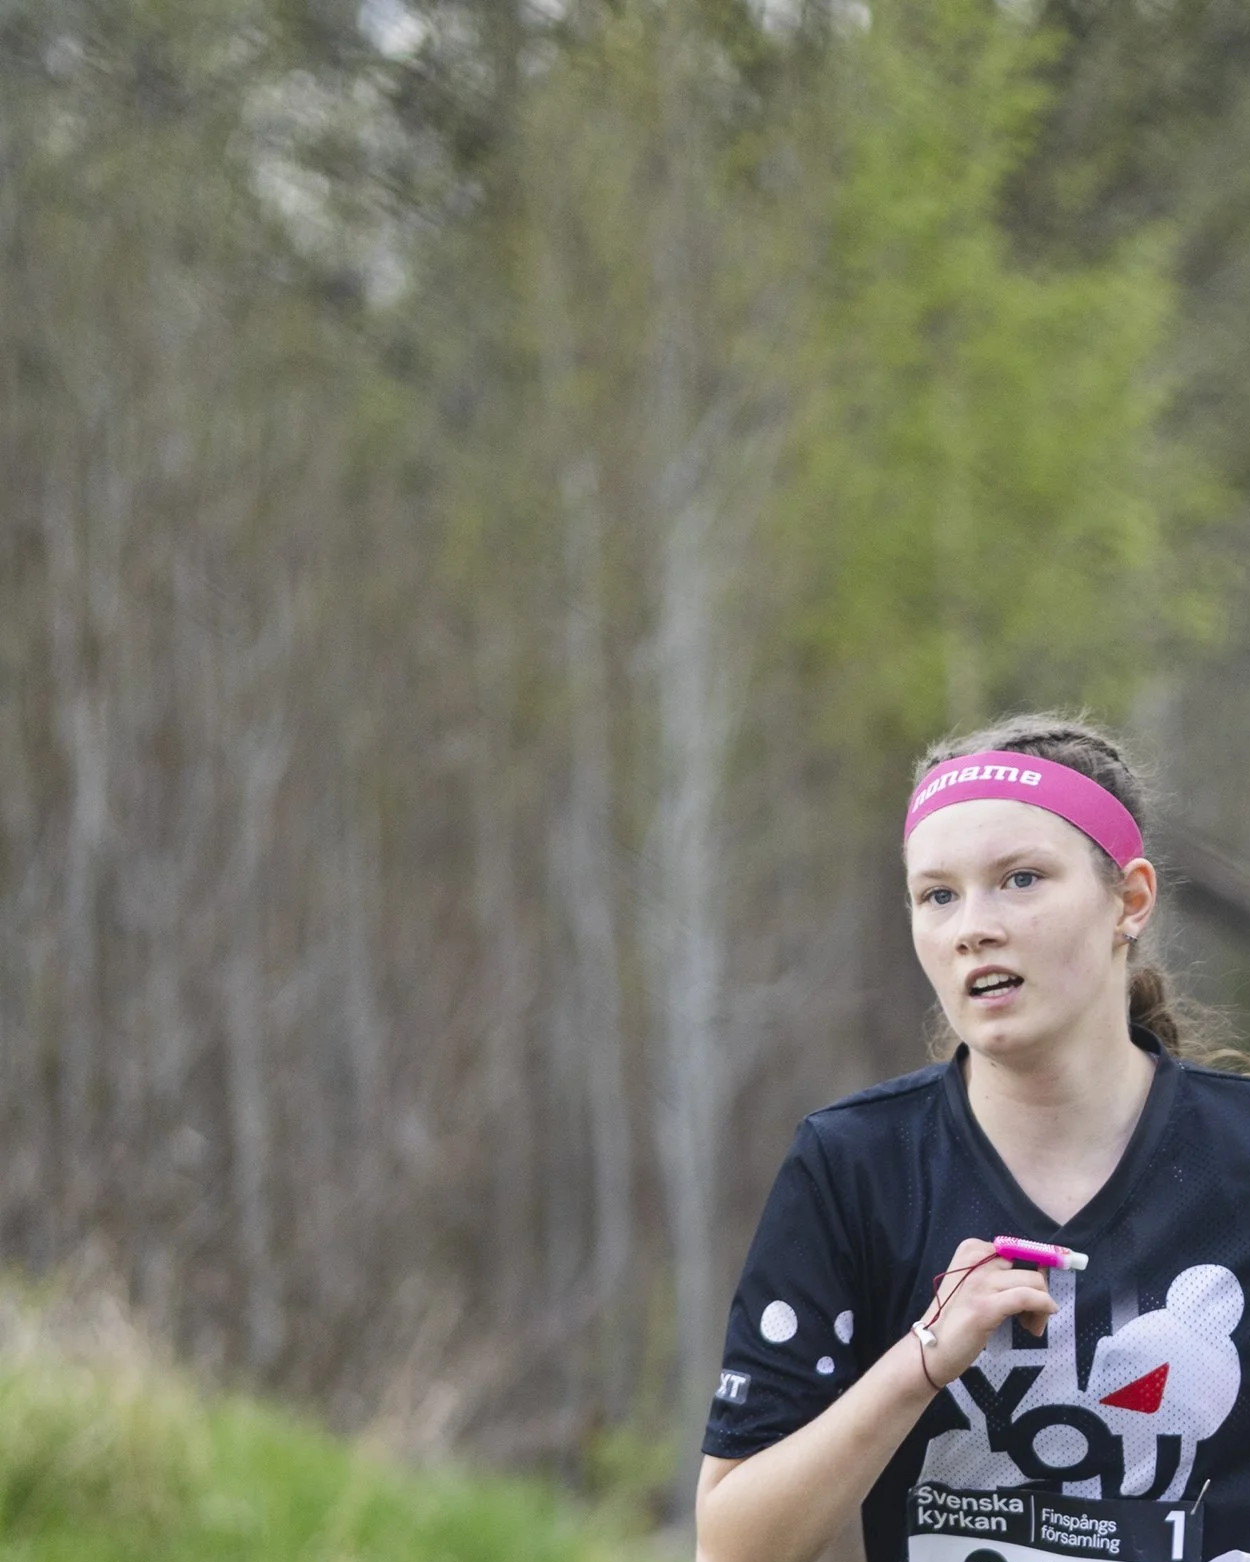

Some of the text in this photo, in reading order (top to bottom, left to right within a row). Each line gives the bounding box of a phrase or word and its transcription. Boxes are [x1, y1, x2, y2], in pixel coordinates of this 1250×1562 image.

[911, 764, 1043, 813] noname
[916, 1485, 1025, 1513] Svenska
[917, 1506, 1008, 1532] kyrkan
[1041, 1507, 1118, 1535] Finspångs
[1041, 1525, 1121, 1554] församling
[1164, 1510, 1187, 1561] 1
